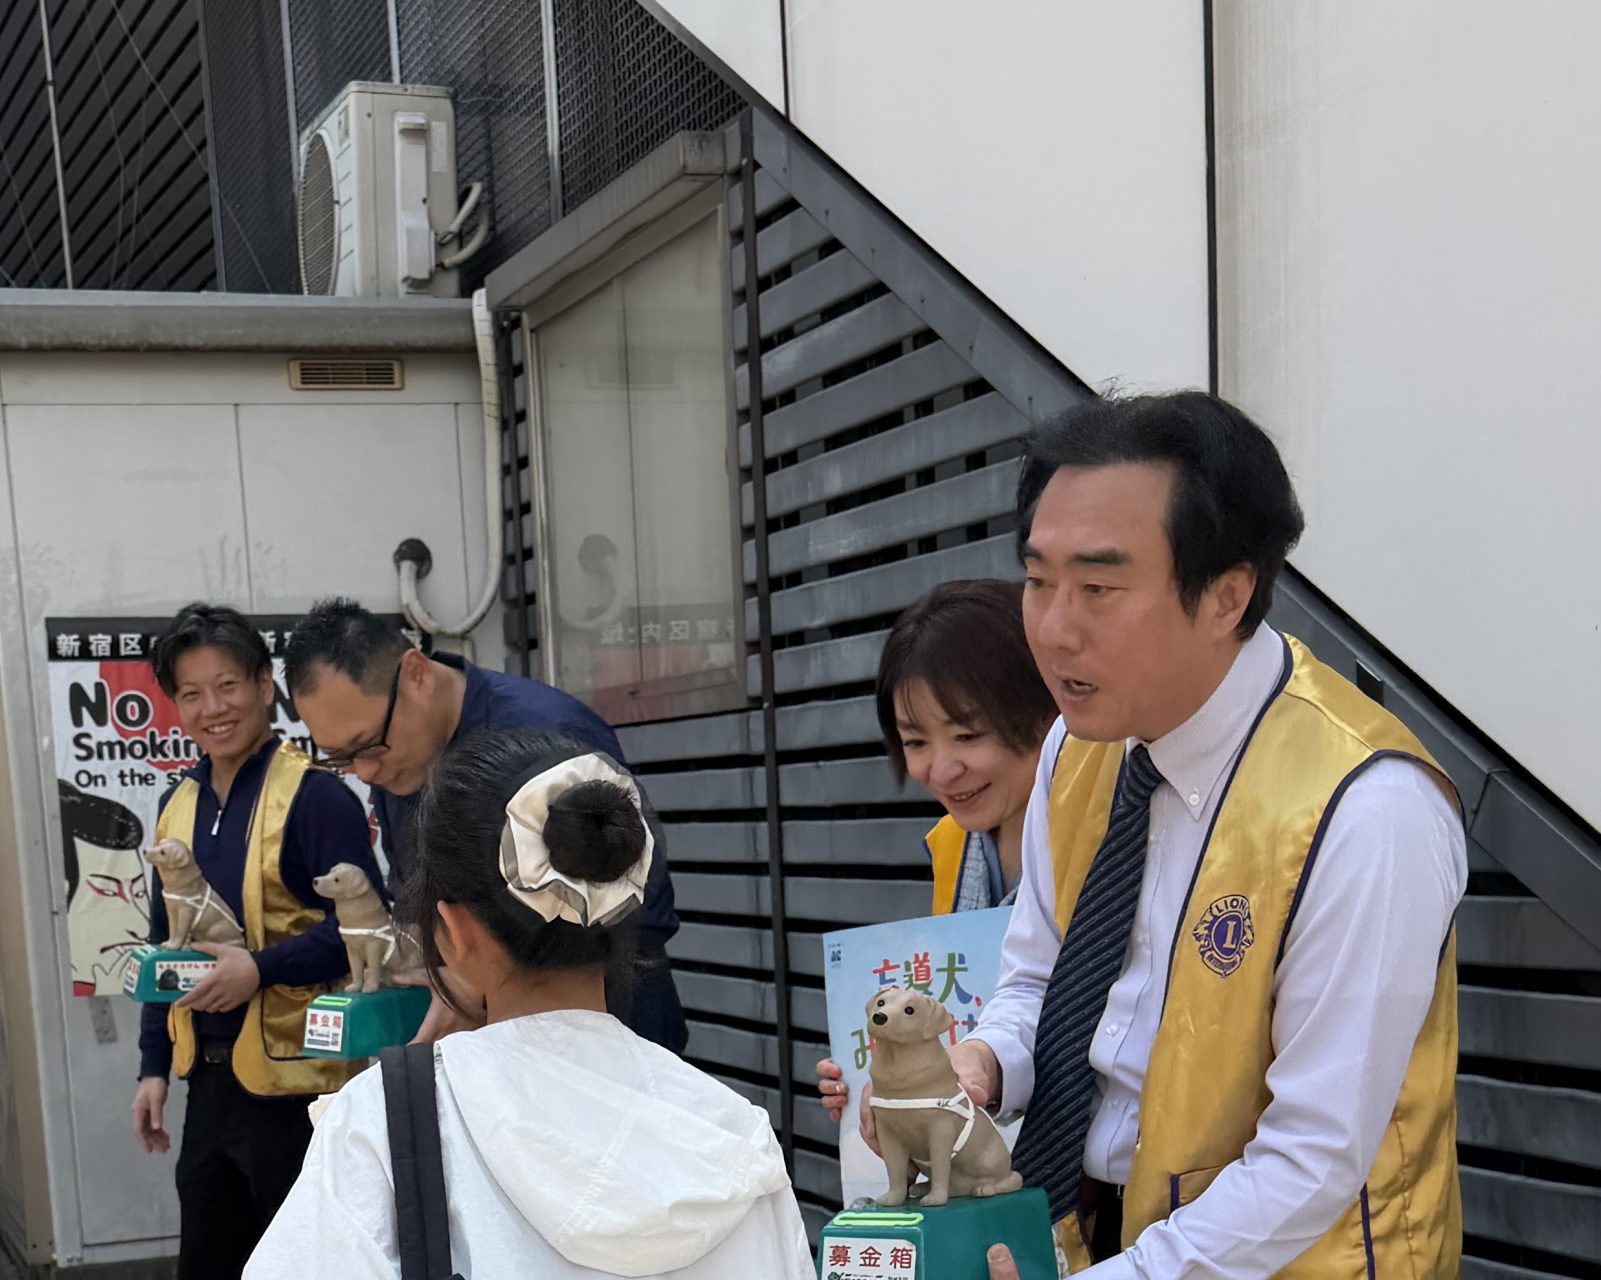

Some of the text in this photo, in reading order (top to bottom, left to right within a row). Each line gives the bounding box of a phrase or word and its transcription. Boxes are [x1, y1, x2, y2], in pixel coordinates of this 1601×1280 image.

[56, 633, 158, 657] 新宿区
[69, 681, 151, 728] No
[73, 730, 202, 762] Smokin
[75, 769, 106, 788] On
[118, 768, 156, 788] the
[829, 1245, 914, 1270] 募金箱
